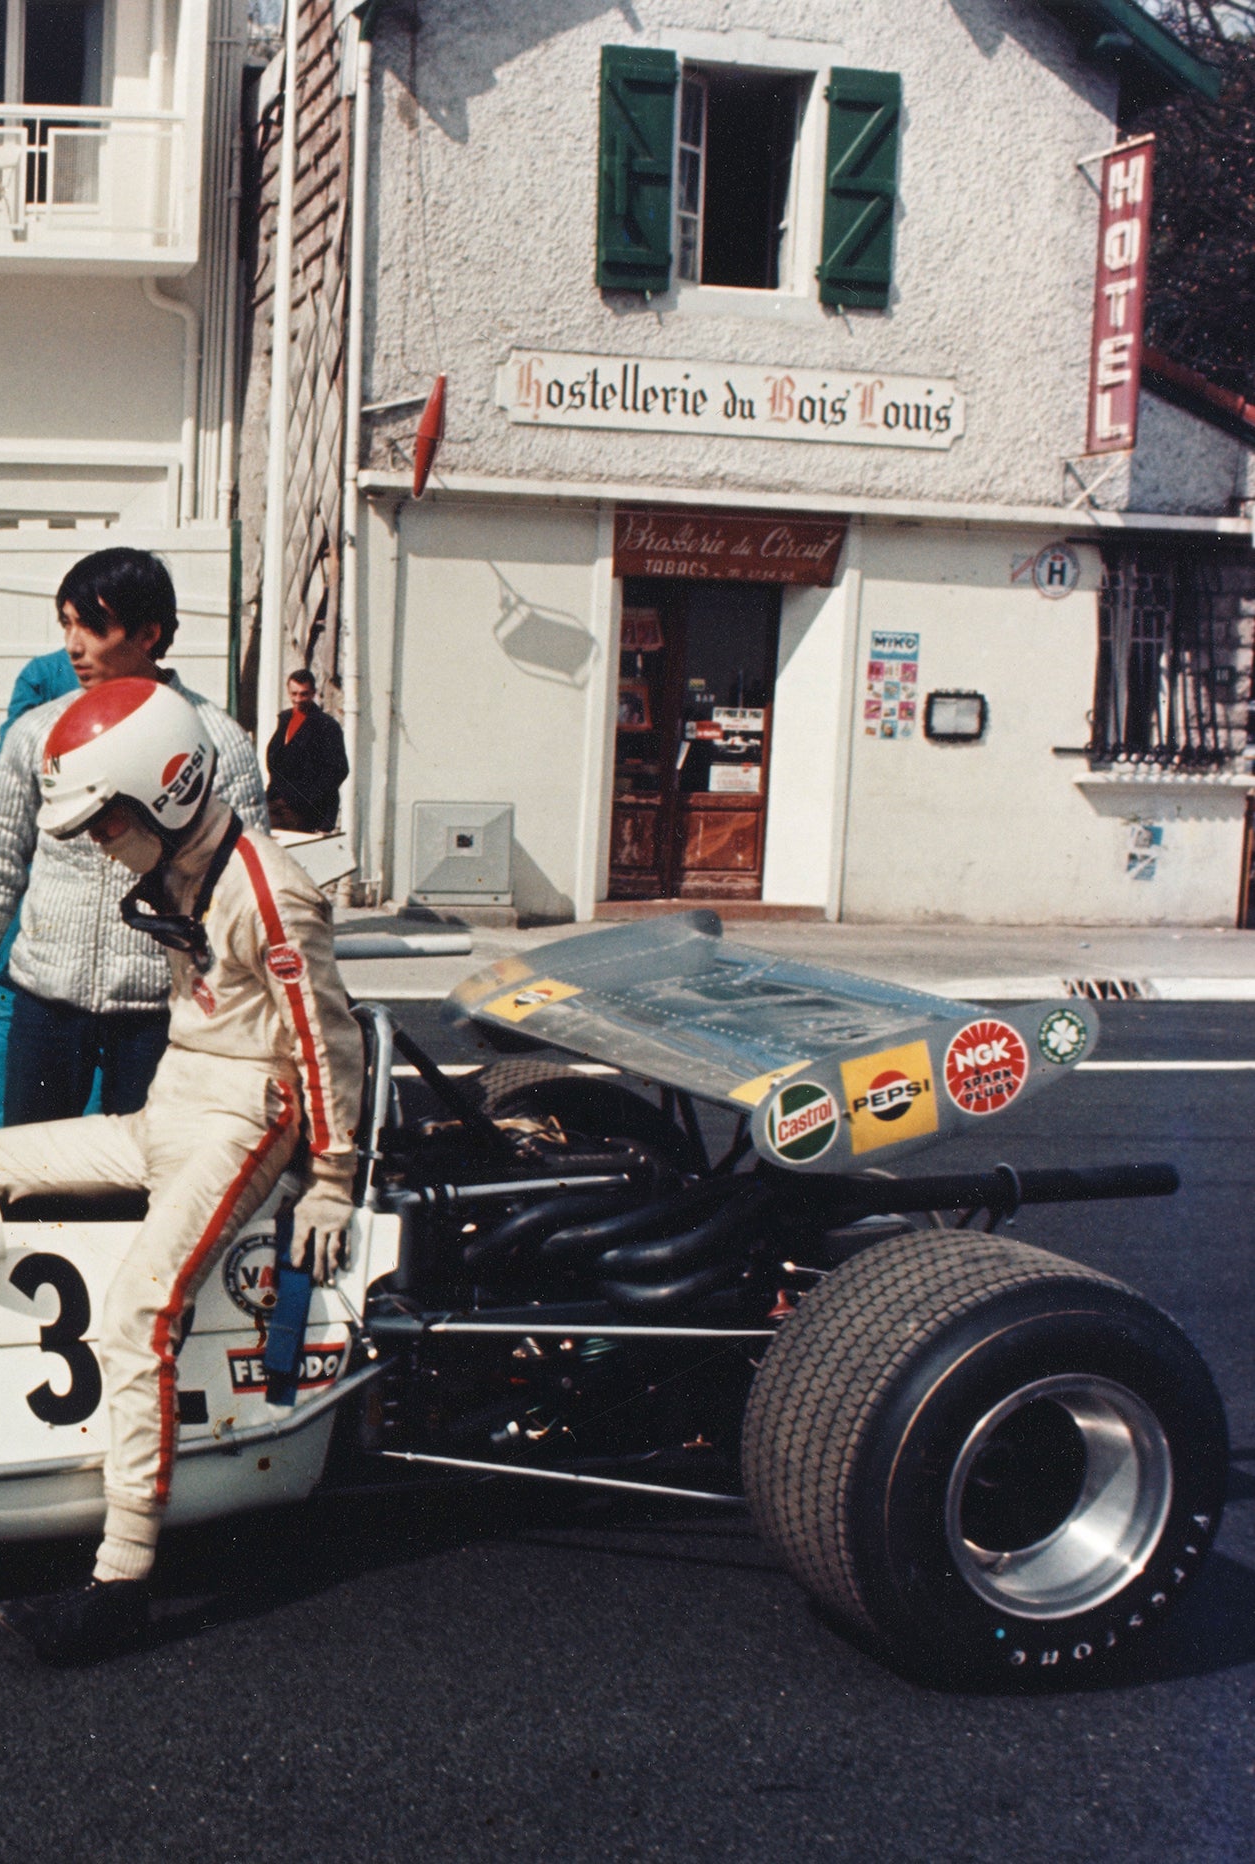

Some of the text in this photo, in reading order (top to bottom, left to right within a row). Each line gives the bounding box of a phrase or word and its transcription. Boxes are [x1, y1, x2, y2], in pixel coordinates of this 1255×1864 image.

[1095, 153, 1145, 441] HOTEL
[723, 380, 757, 420] du
[765, 374, 850, 426] Bois
[854, 380, 954, 436] Louis
[618, 514, 842, 566] Brasserie du Circuit
[645, 558, 709, 577] TABACS
[1048, 561, 1067, 586] H
[874, 636, 915, 649] MIKO
[151, 742, 207, 814] PEPSI
[954, 1036, 1012, 1073] NGK
[852, 1078, 931, 1113] PEPSI
[963, 1067, 1013, 1090] SPARK
[964, 1081, 1014, 1104] PLUGS
[777, 1097, 833, 1143] Castrol
[232, 1354, 339, 1383] FEDO
